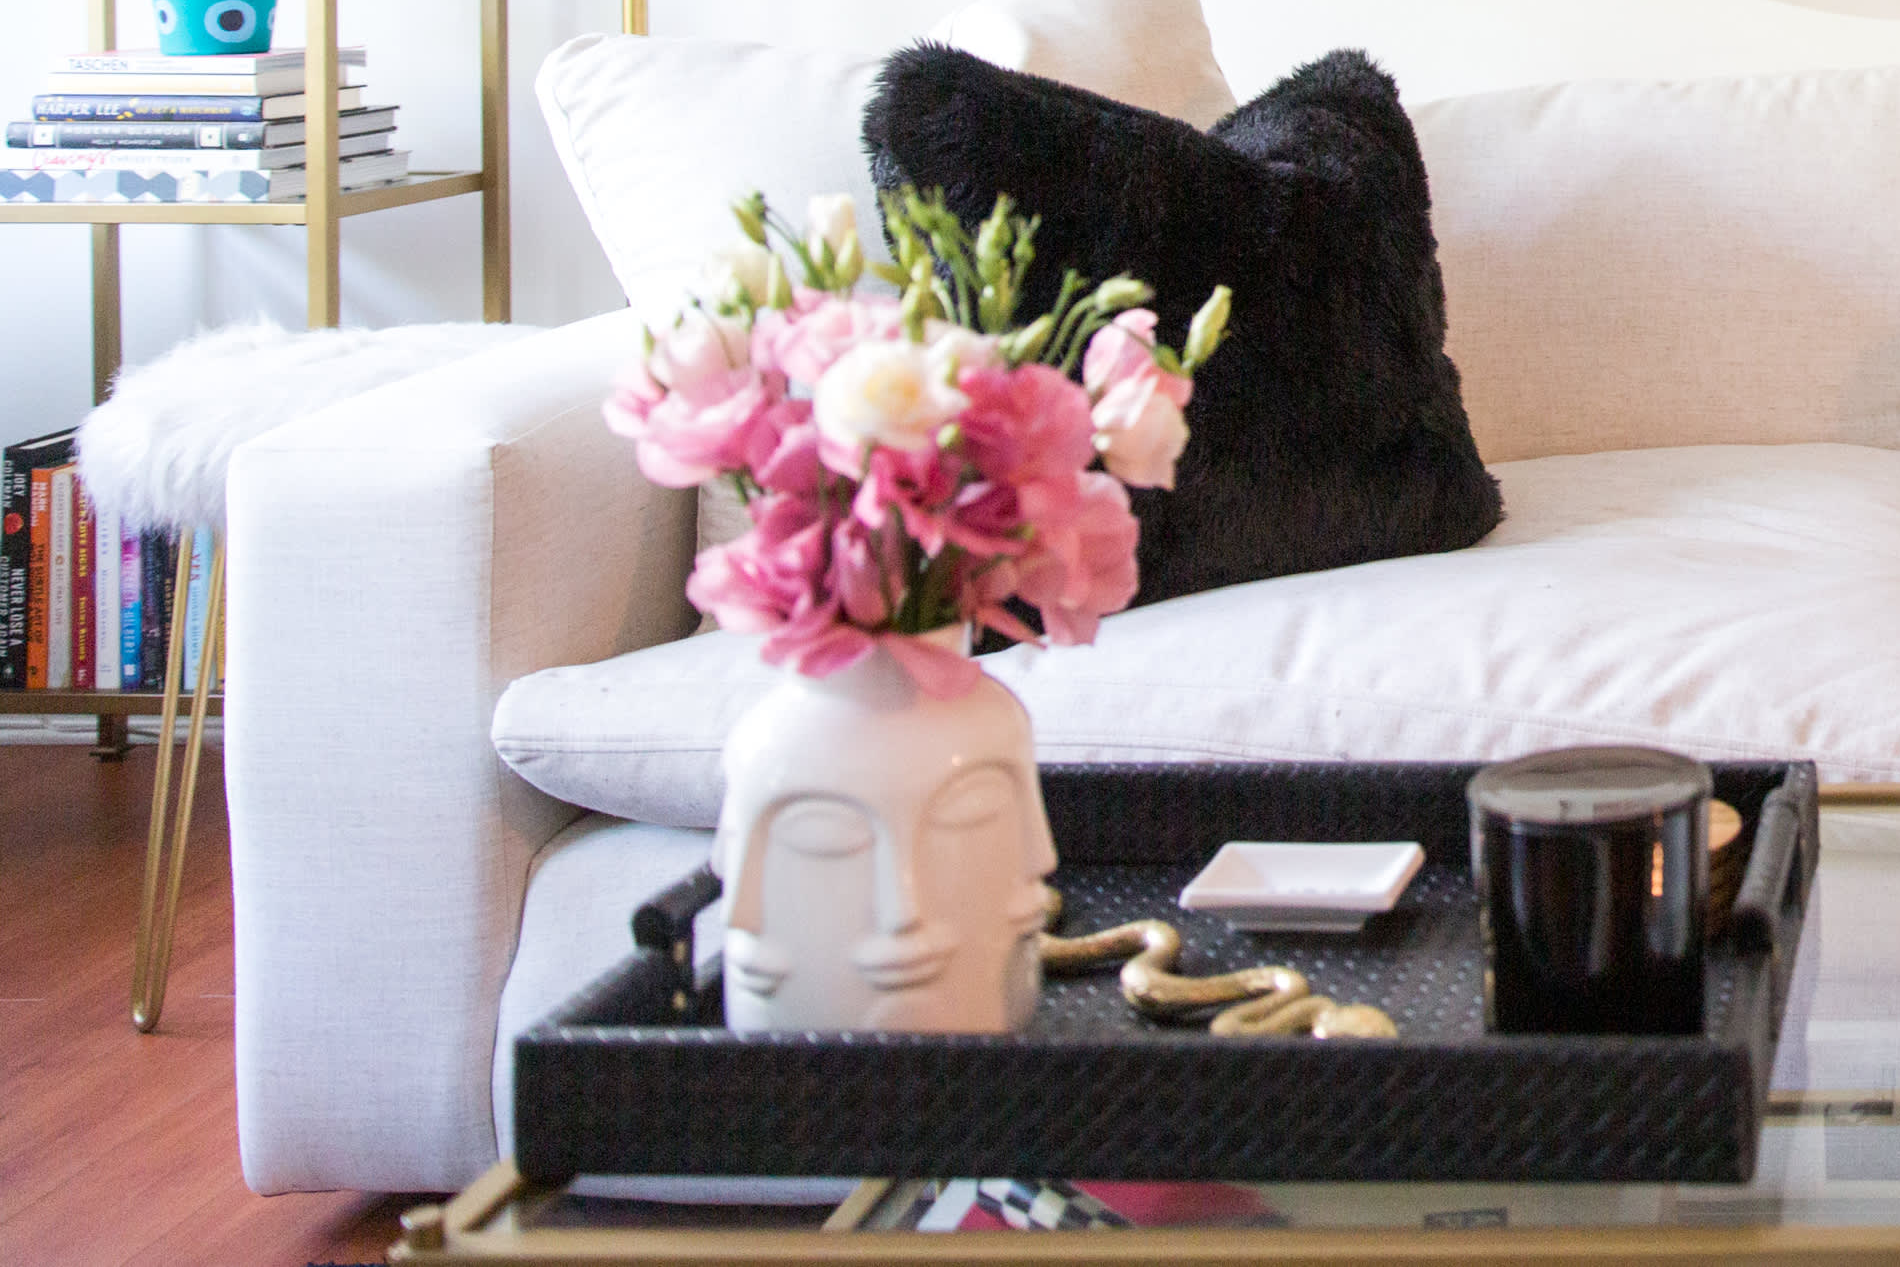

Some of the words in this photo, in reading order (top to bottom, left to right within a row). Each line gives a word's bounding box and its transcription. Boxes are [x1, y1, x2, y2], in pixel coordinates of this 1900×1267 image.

[68, 58, 128, 71] TASCHEN
[36, 102, 92, 116] HARPER
[96, 102, 121, 116] LEE
[13, 473, 26, 497] JOEY
[38, 481, 48, 512] MARK
[11, 568, 25, 604] NEVER
[10, 607, 24, 635] LOSE
[9, 638, 24, 647] A
